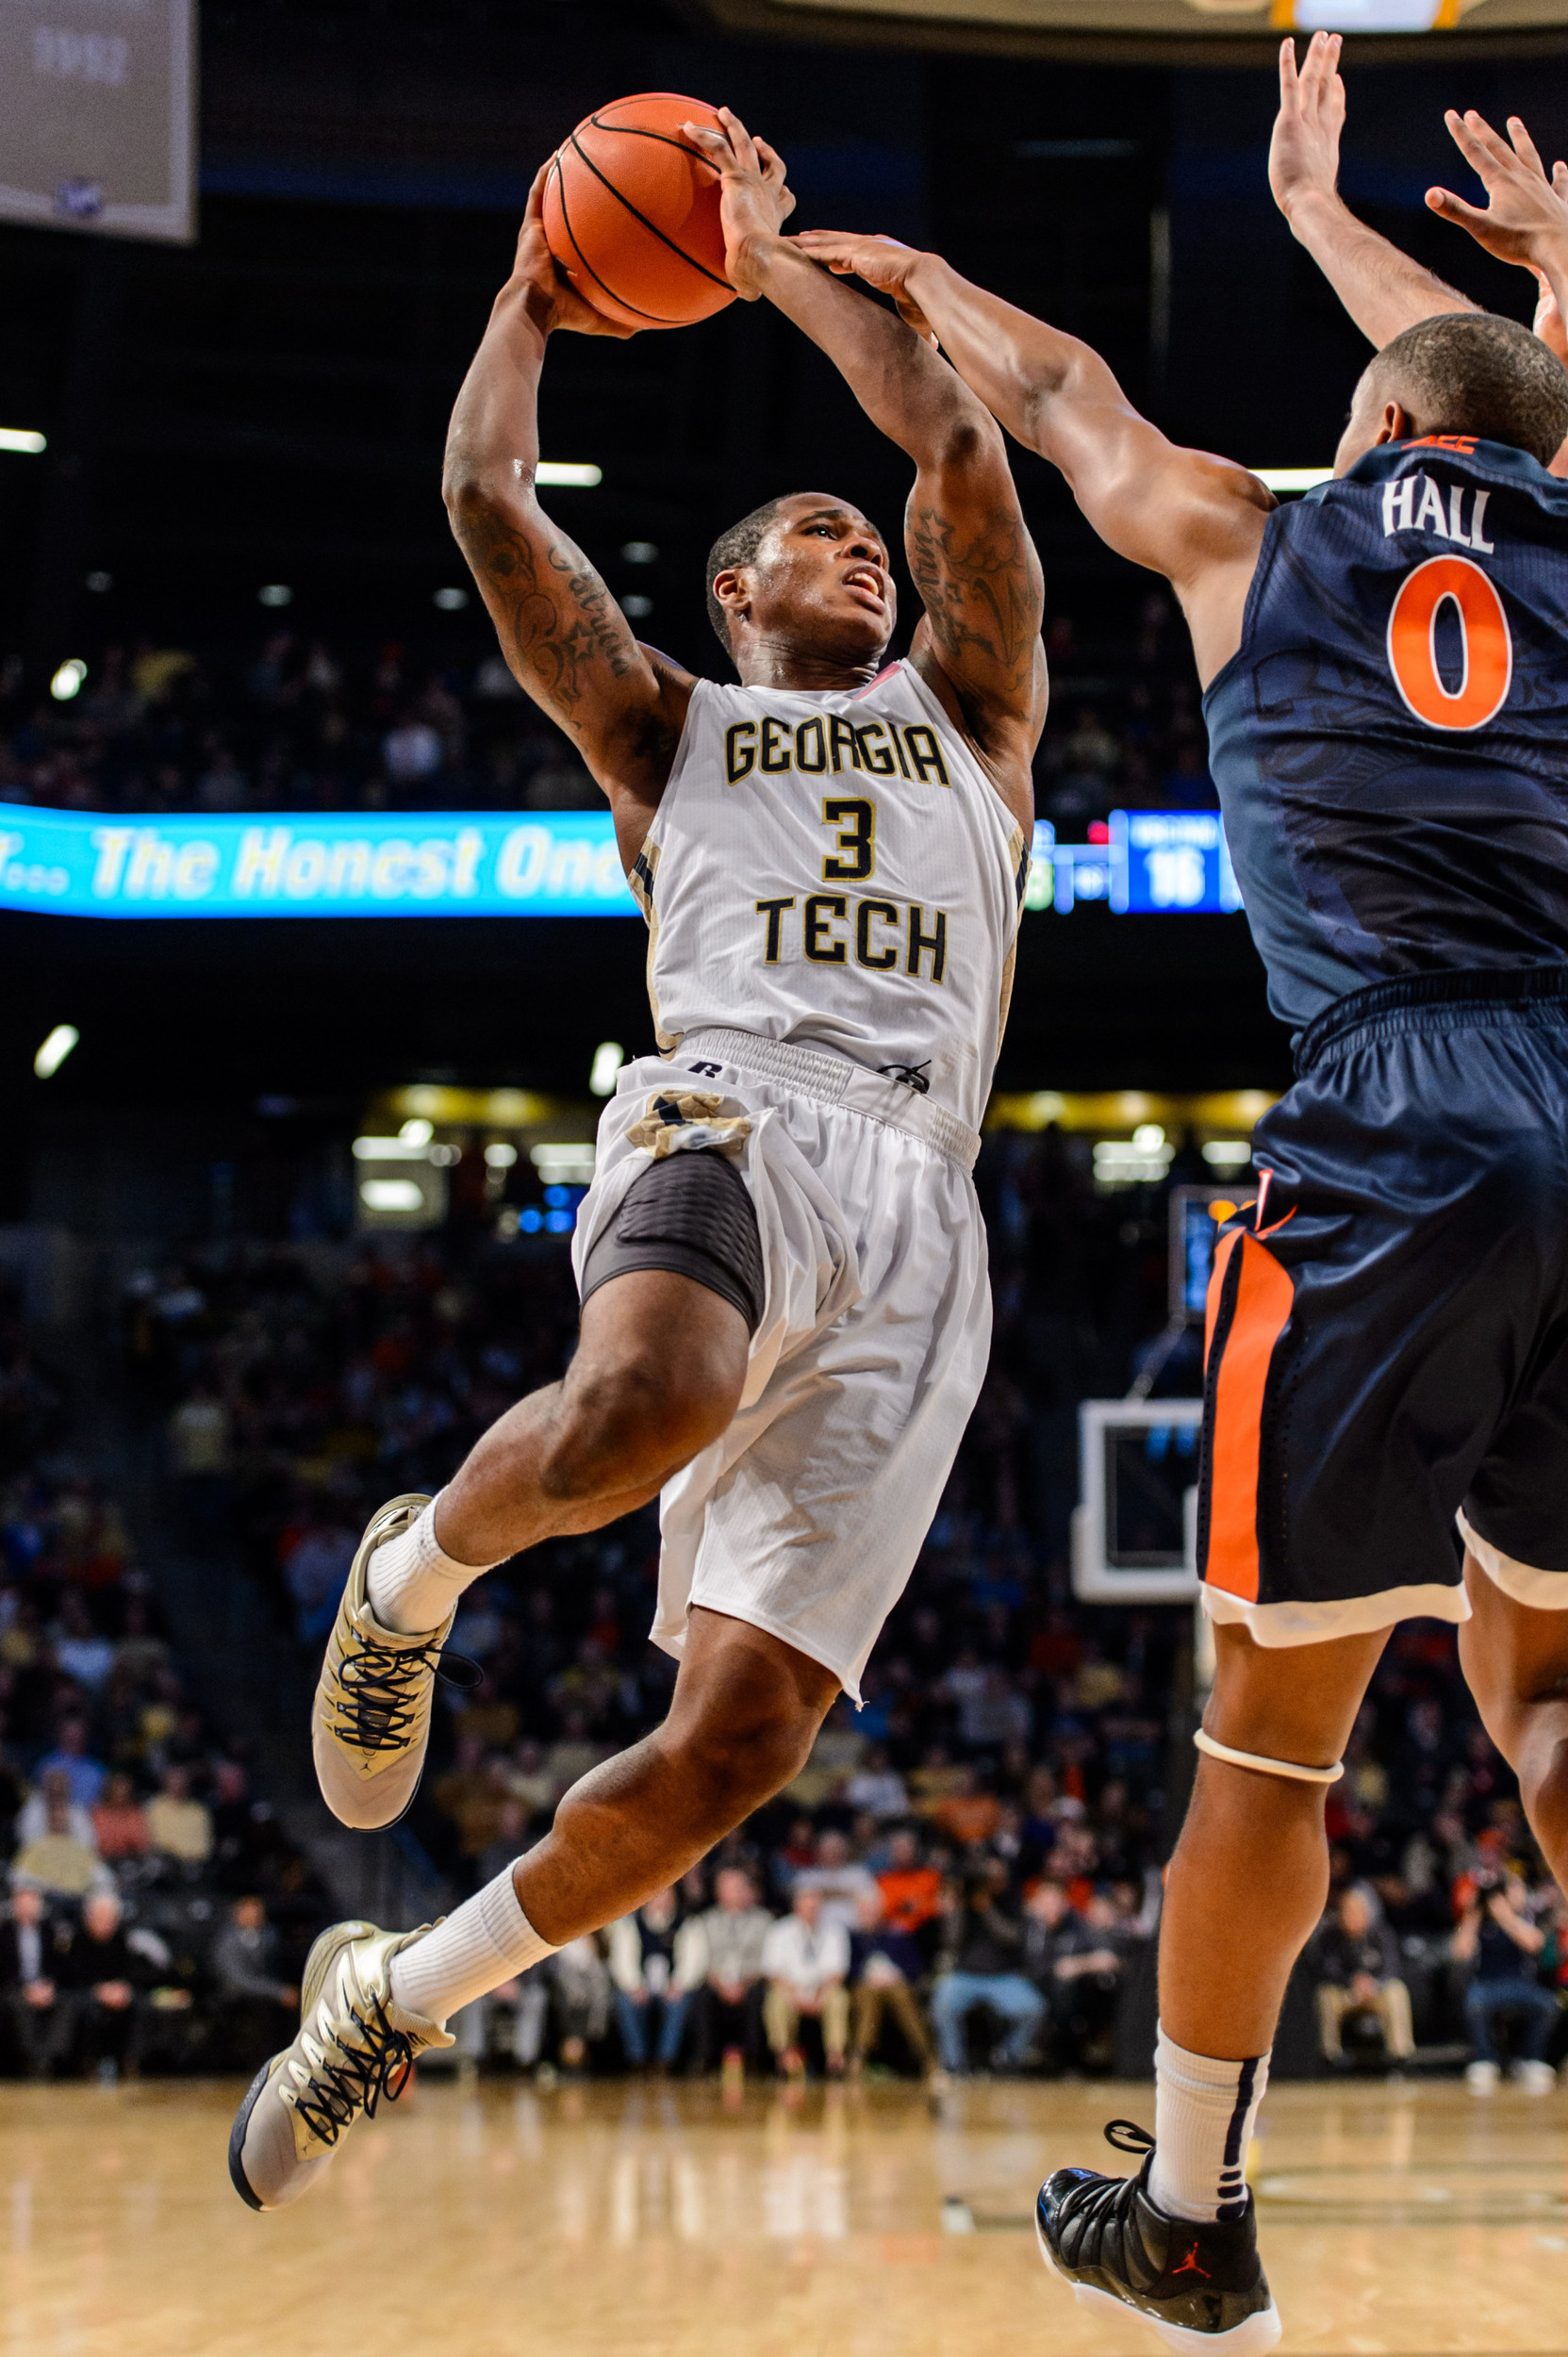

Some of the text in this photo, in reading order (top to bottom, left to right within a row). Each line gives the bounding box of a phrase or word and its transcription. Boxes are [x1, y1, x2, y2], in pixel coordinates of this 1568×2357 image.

[1402, 435, 1480, 454] ACC
[1382, 474, 1494, 554] HALL
[1386, 553, 1512, 732] 0
[725, 713, 951, 788] GEORGIA
[92, 826, 219, 898] The
[232, 826, 487, 898] Honest
[822, 797, 875, 882] 3
[755, 894, 947, 984] TECH
